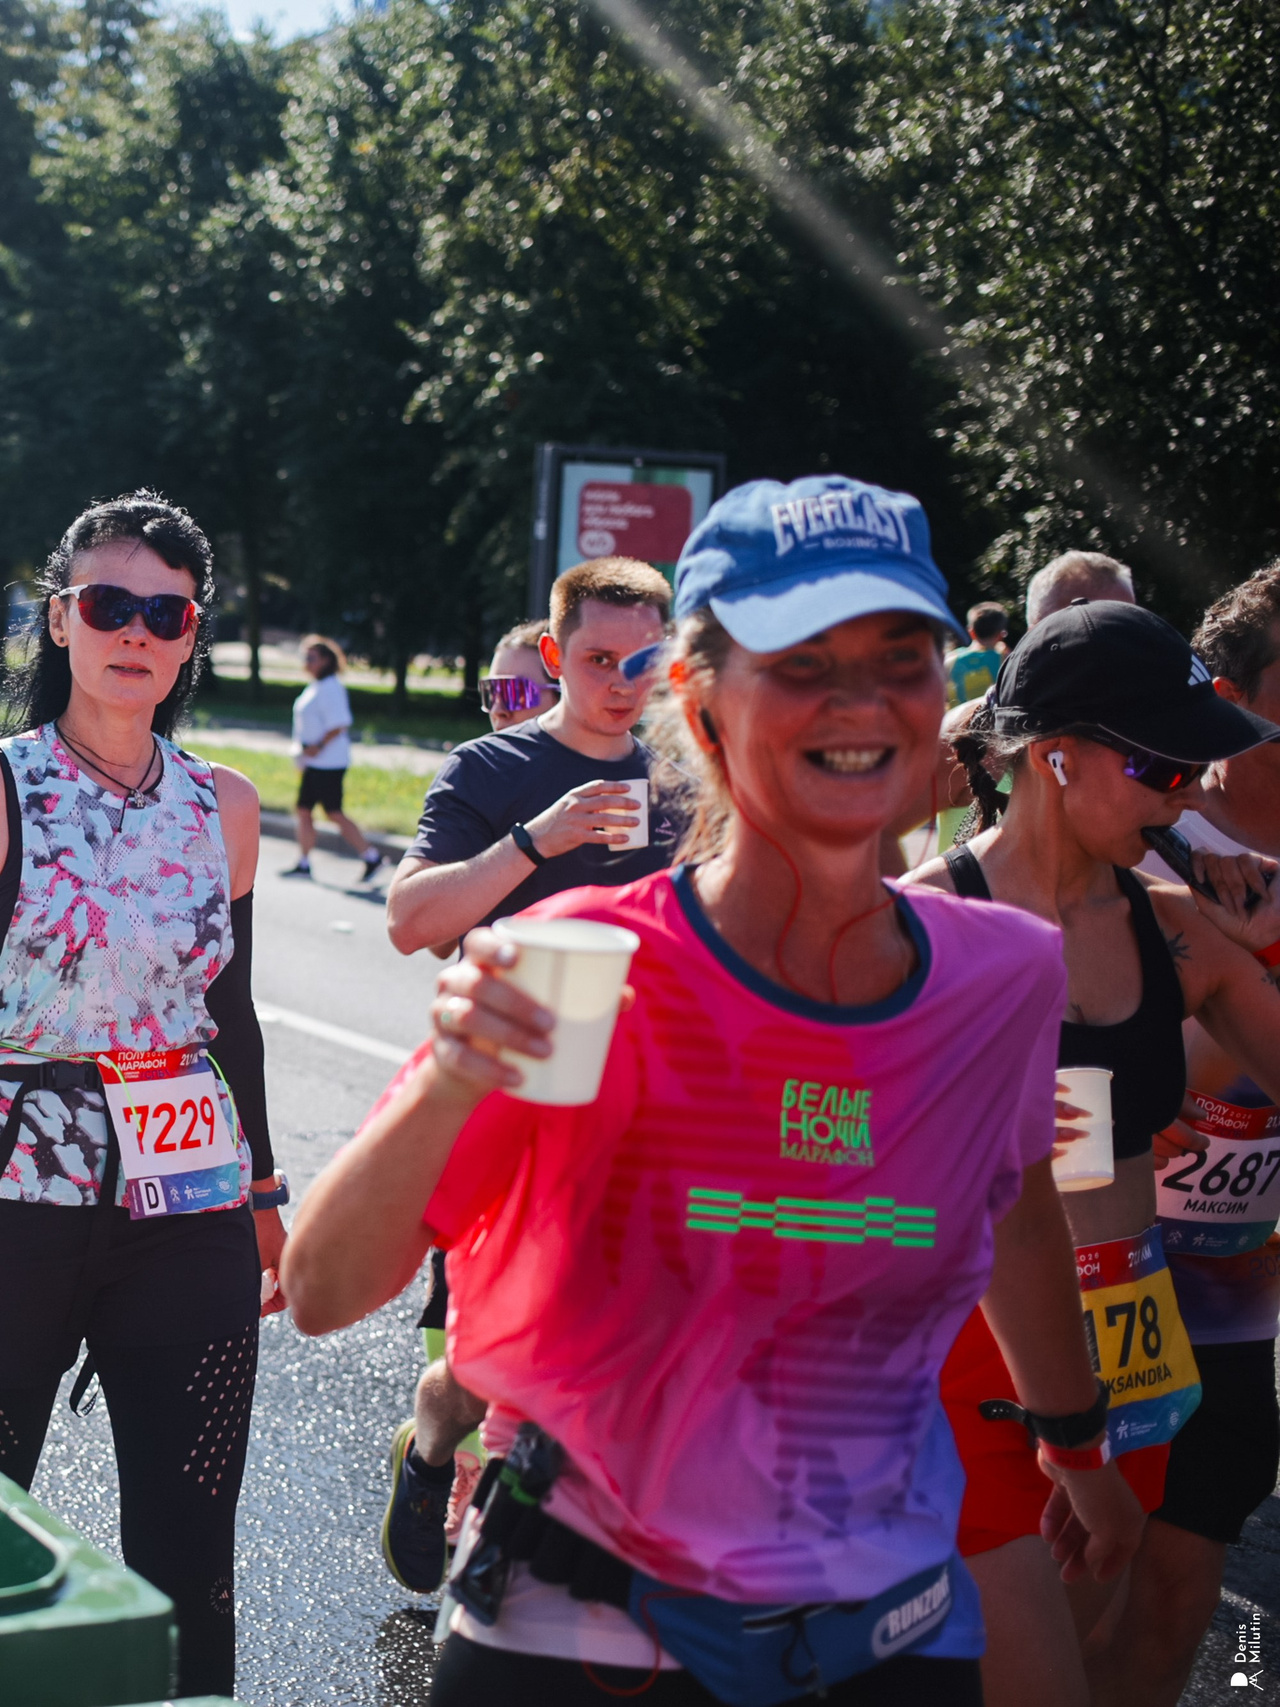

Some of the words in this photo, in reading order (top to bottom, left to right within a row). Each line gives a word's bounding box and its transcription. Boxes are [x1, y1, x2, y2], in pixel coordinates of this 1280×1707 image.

[771, 491, 912, 557] EVERLAST
[116, 1058, 167, 1071] МАРАФОН
[117, 1051, 145, 1061] ПОЛУ
[781, 1078, 872, 1120] БЕЛЫЕ
[1196, 1097, 1230, 1116] ПОЛУ
[122, 1095, 215, 1155] 7229
[780, 1109, 872, 1148] НОЧИ
[780, 1141, 876, 1167] МАРАФОН
[1161, 1149, 1280, 1197] 2687
[144, 1181, 161, 1209] D
[1183, 1198, 1250, 1215] МАКСИМ
[1079, 1251, 1100, 1263] 026
[1104, 1362, 1173, 1396] KSANDRA
